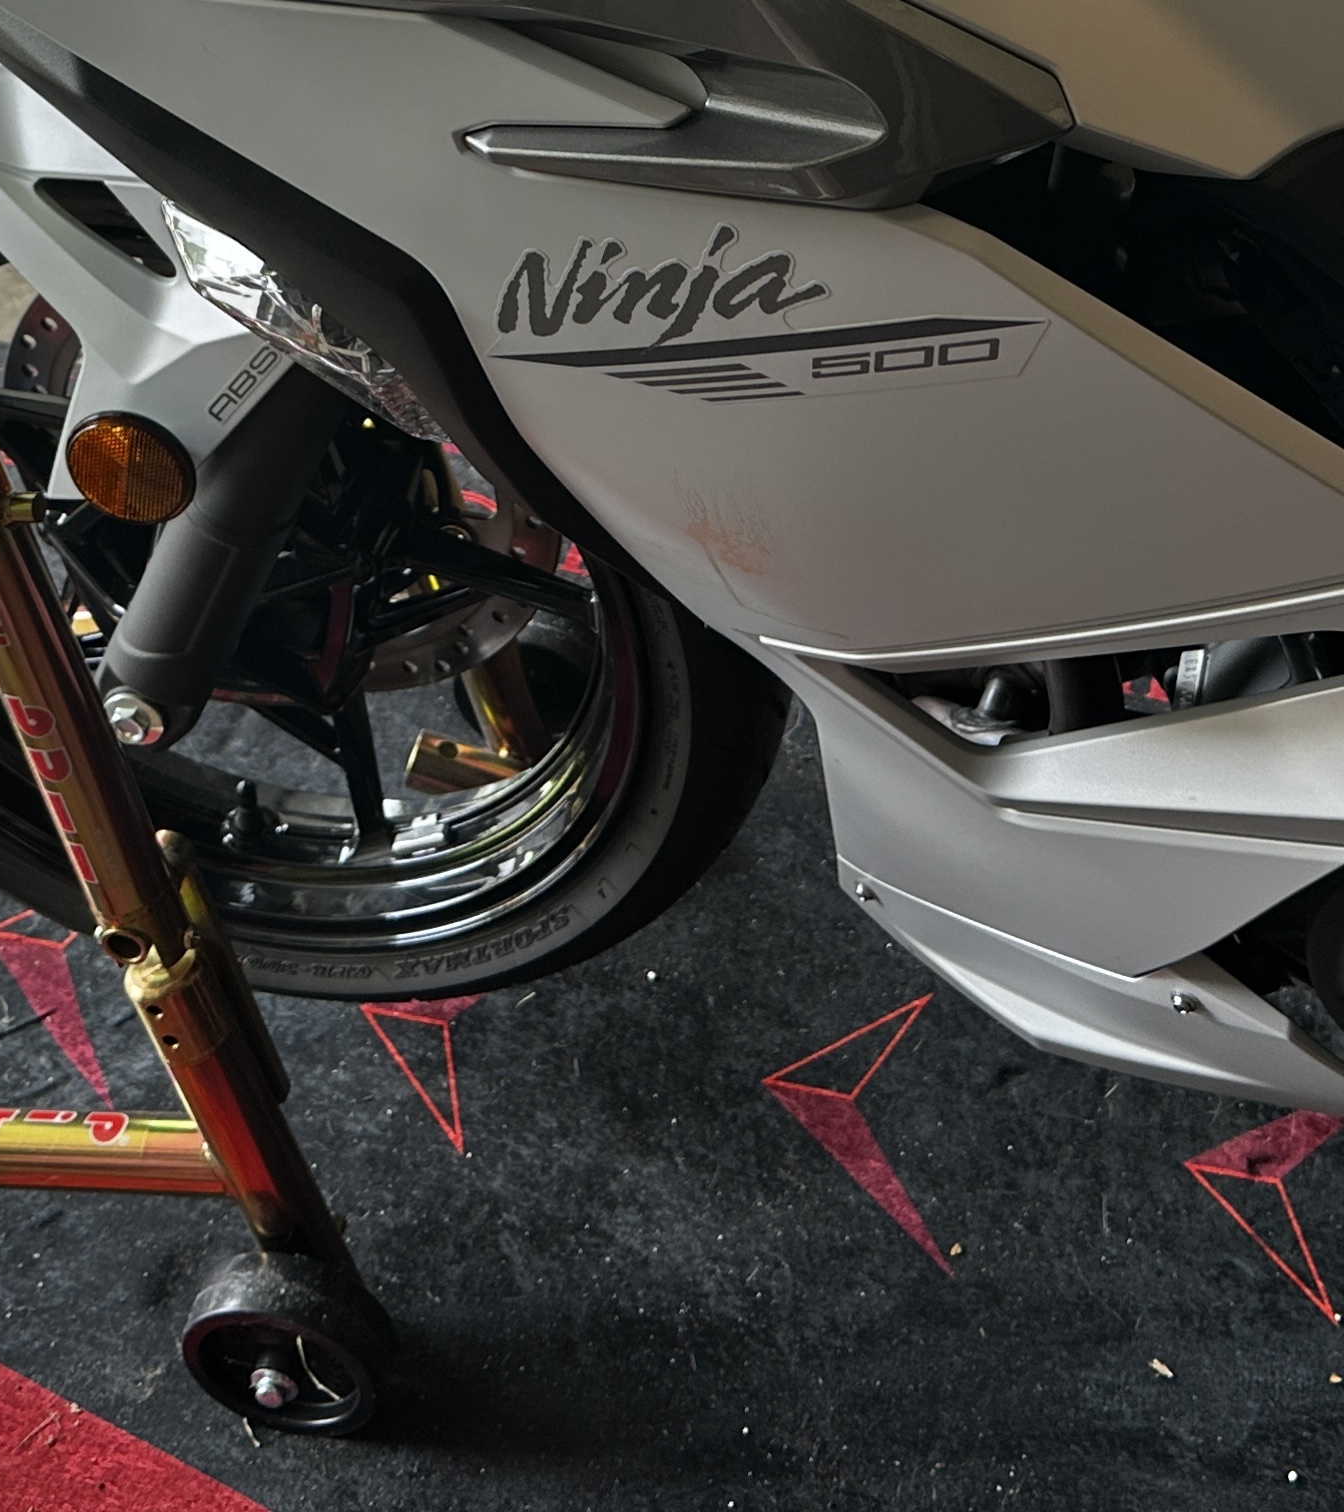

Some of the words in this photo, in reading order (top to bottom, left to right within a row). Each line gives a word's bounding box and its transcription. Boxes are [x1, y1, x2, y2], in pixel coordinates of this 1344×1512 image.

[497, 224, 827, 347] Ninja
[207, 346, 278, 422] ABS
[811, 337, 1000, 380] 500
[391, 906, 570, 979] SPORTMAX
